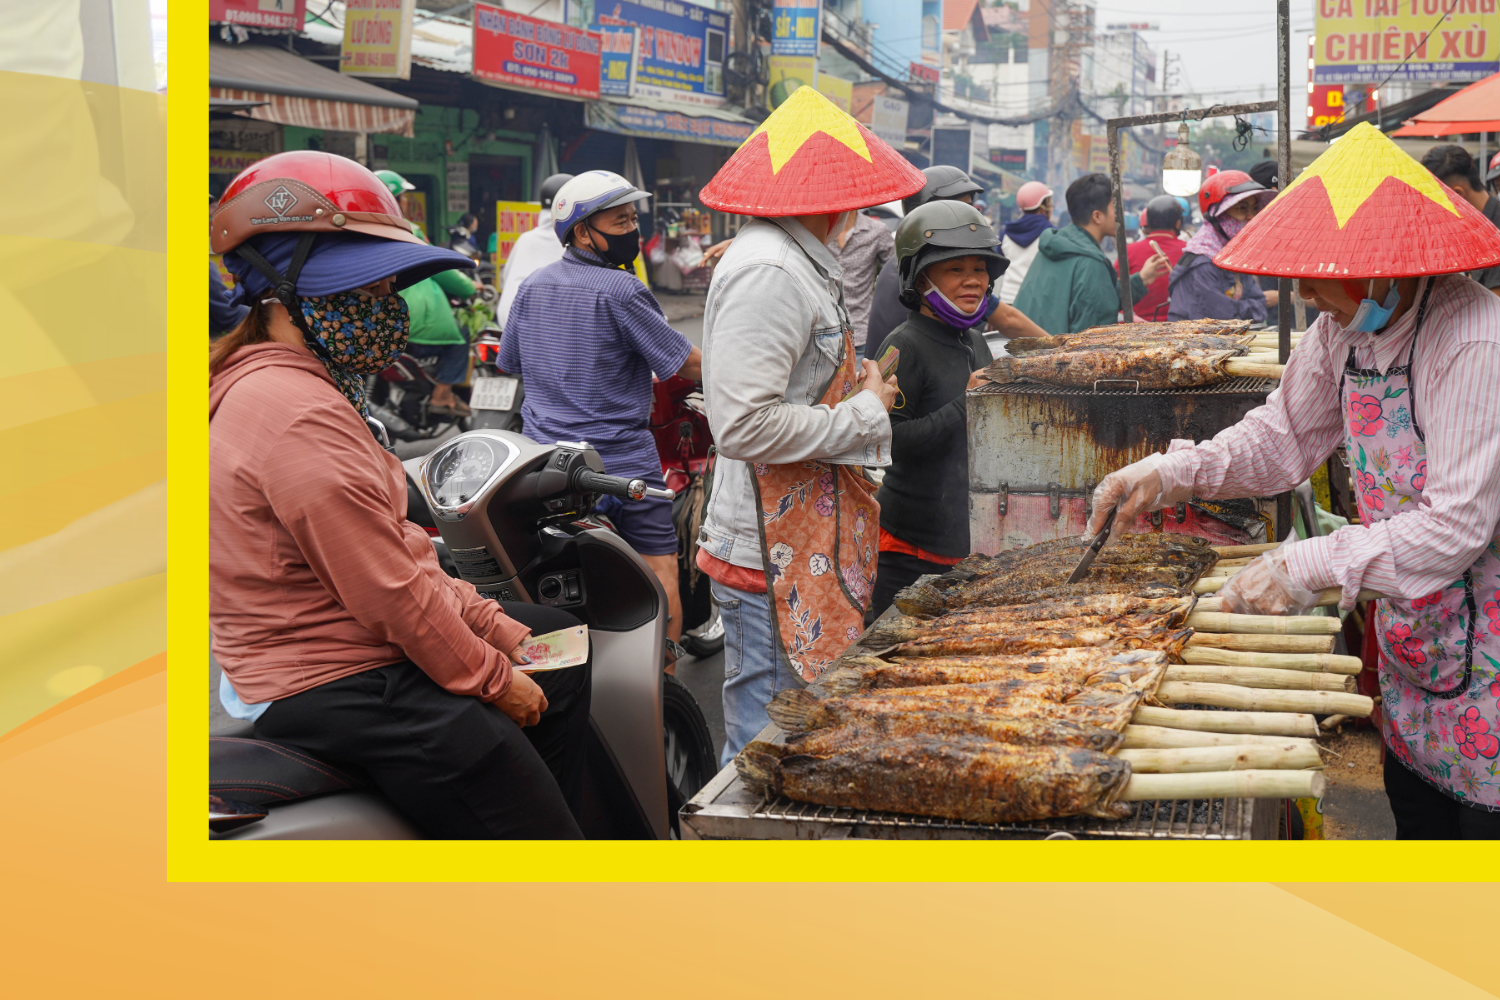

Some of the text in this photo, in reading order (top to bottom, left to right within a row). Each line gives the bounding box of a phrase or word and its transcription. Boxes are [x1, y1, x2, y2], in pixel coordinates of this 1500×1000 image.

[513, 40, 547, 65] SƠN
[655, 28, 703, 69] WINDOW
[1324, 23, 1487, 62] CHIÊN XÙ
[262, 217, 278, 225] Long
[279, 215, 291, 223] Van
